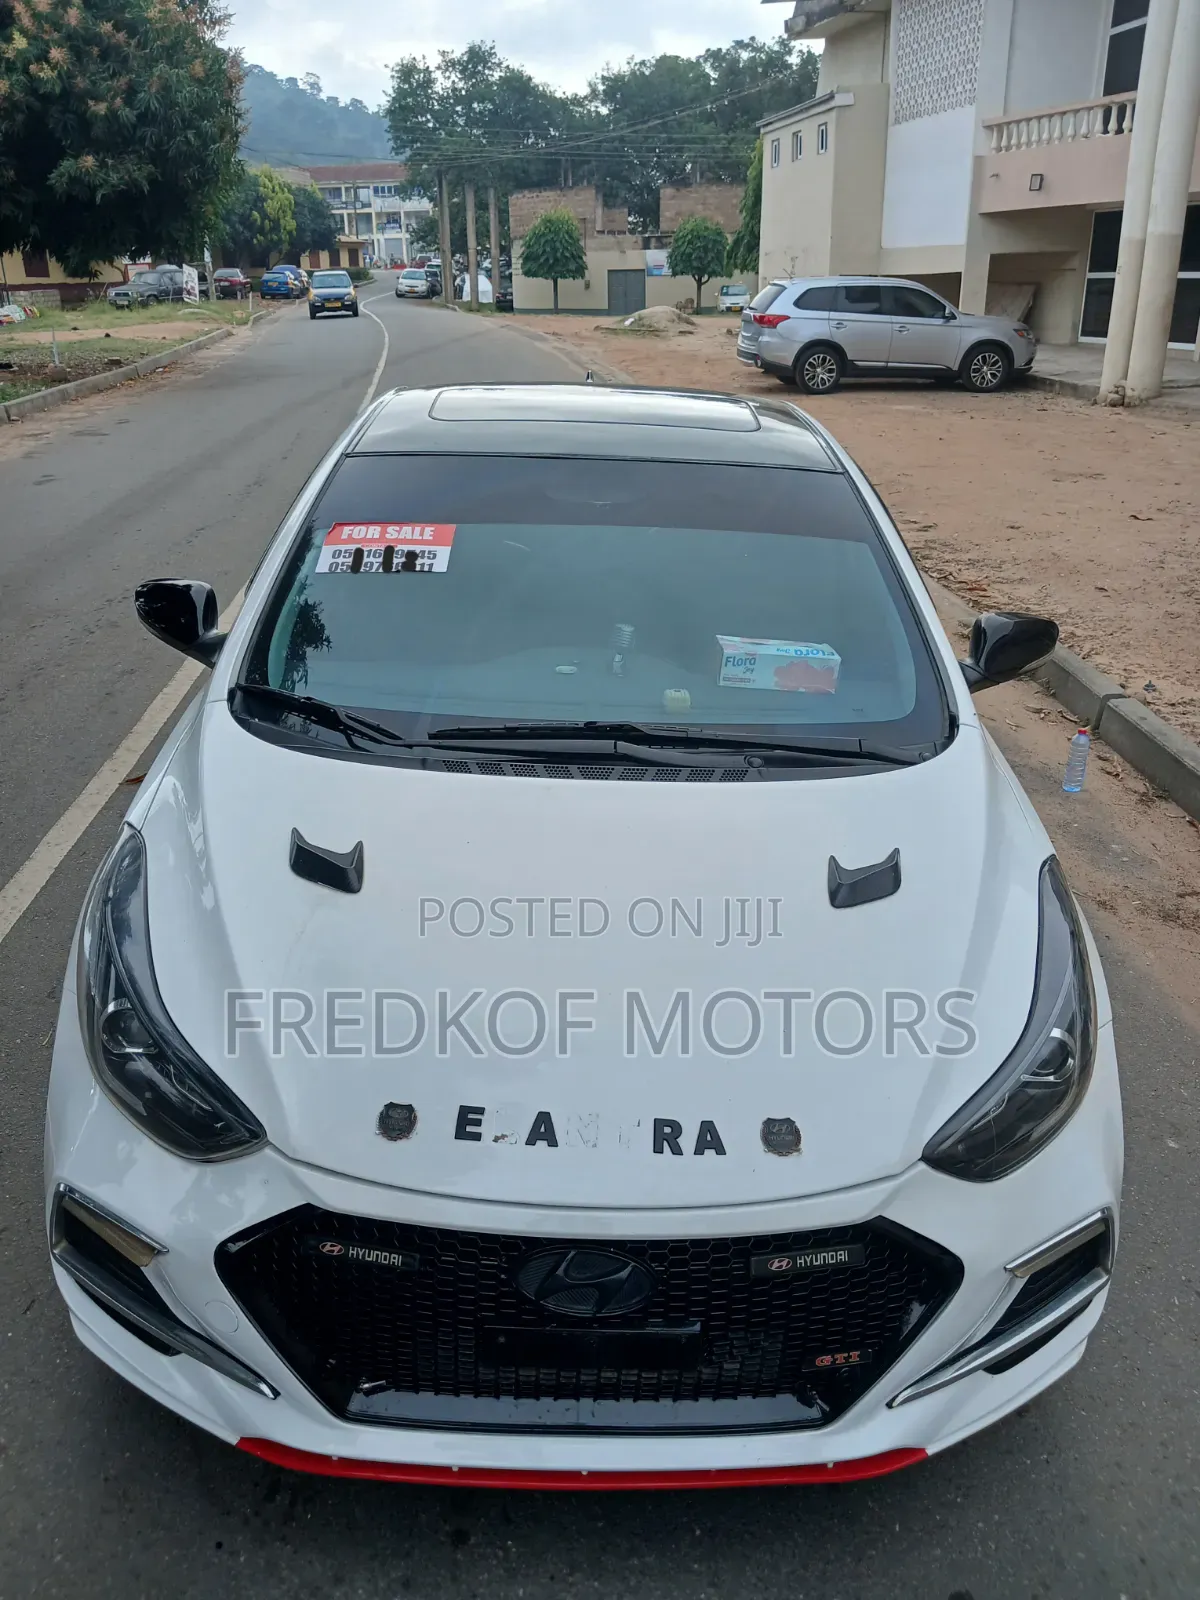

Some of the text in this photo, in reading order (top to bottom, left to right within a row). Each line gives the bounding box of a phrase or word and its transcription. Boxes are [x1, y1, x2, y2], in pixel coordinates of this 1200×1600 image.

[341, 526, 436, 540] FOR SALE
[332, 548, 438, 560] 0516945
[724, 655, 757, 667] Flora
[348, 1246, 403, 1267] HYUNDAI
[796, 1250, 849, 1268] HYUNDAI
[815, 1351, 861, 1367] GTI
